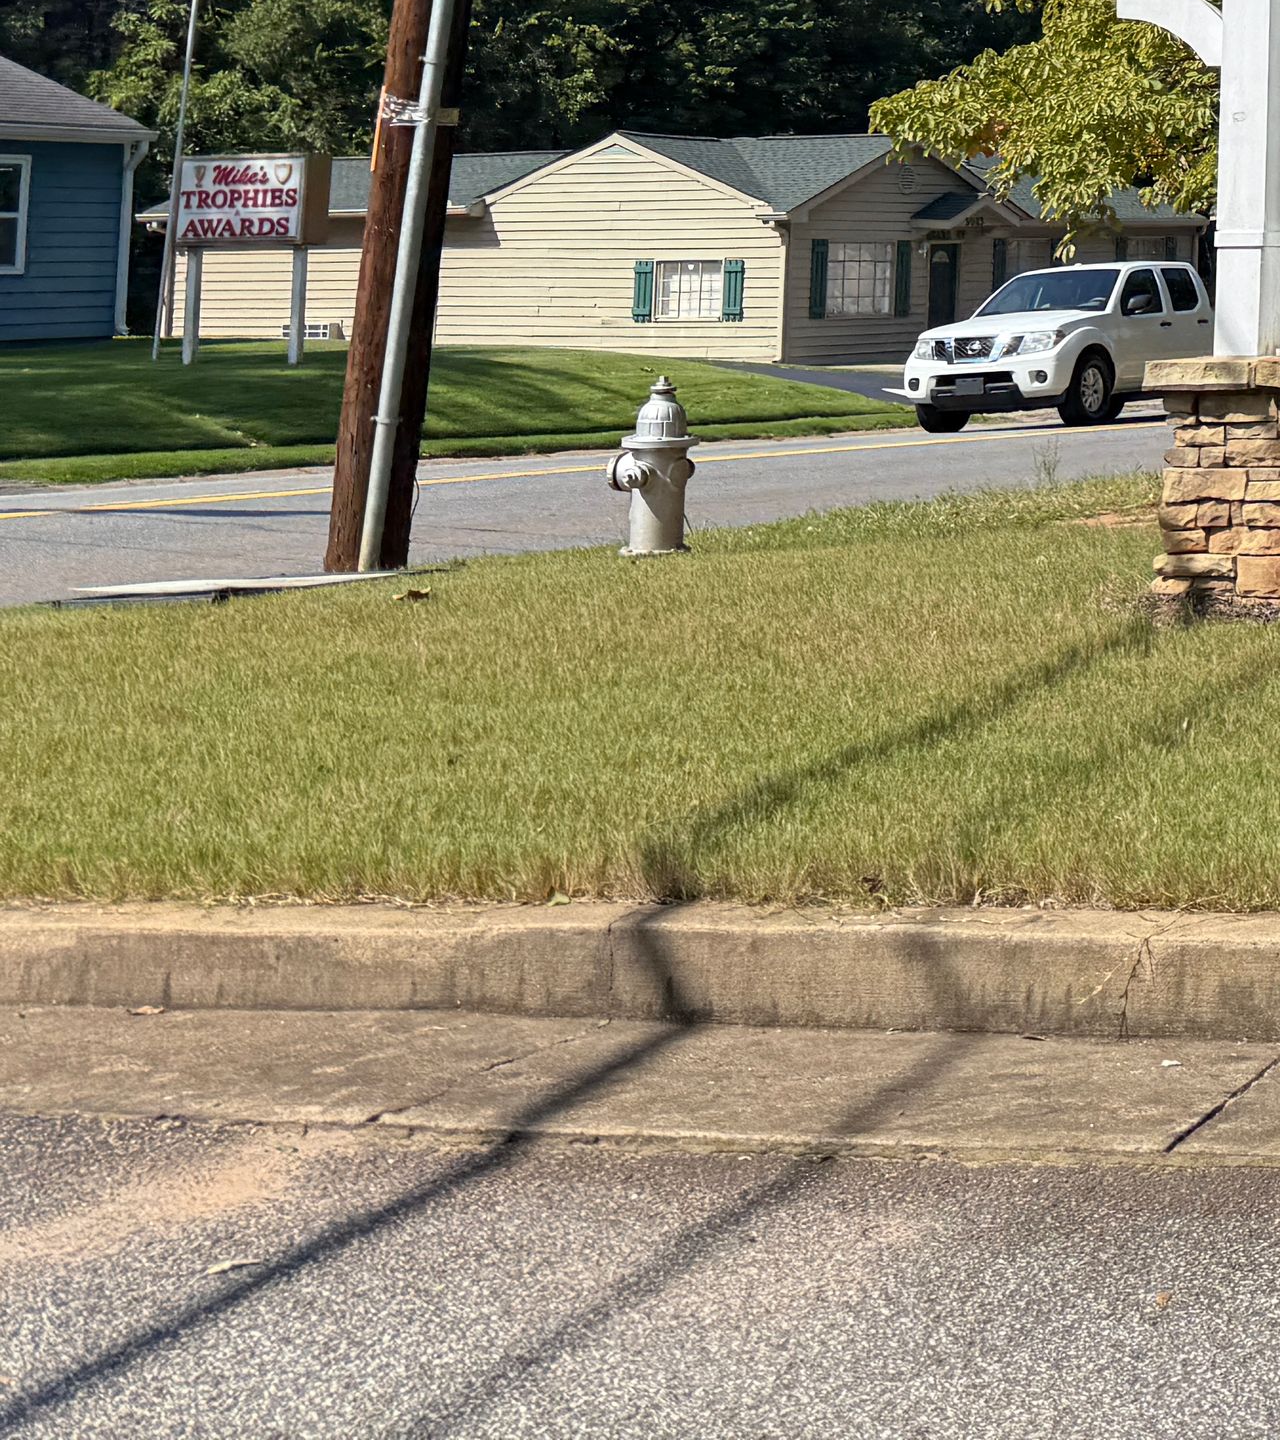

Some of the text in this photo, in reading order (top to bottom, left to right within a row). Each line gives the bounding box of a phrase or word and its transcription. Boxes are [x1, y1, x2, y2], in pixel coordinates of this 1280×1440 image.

[212, 163, 270, 186] Mike's
[180, 187, 298, 210] TROPHIES
[181, 216, 290, 238] AWARDS
